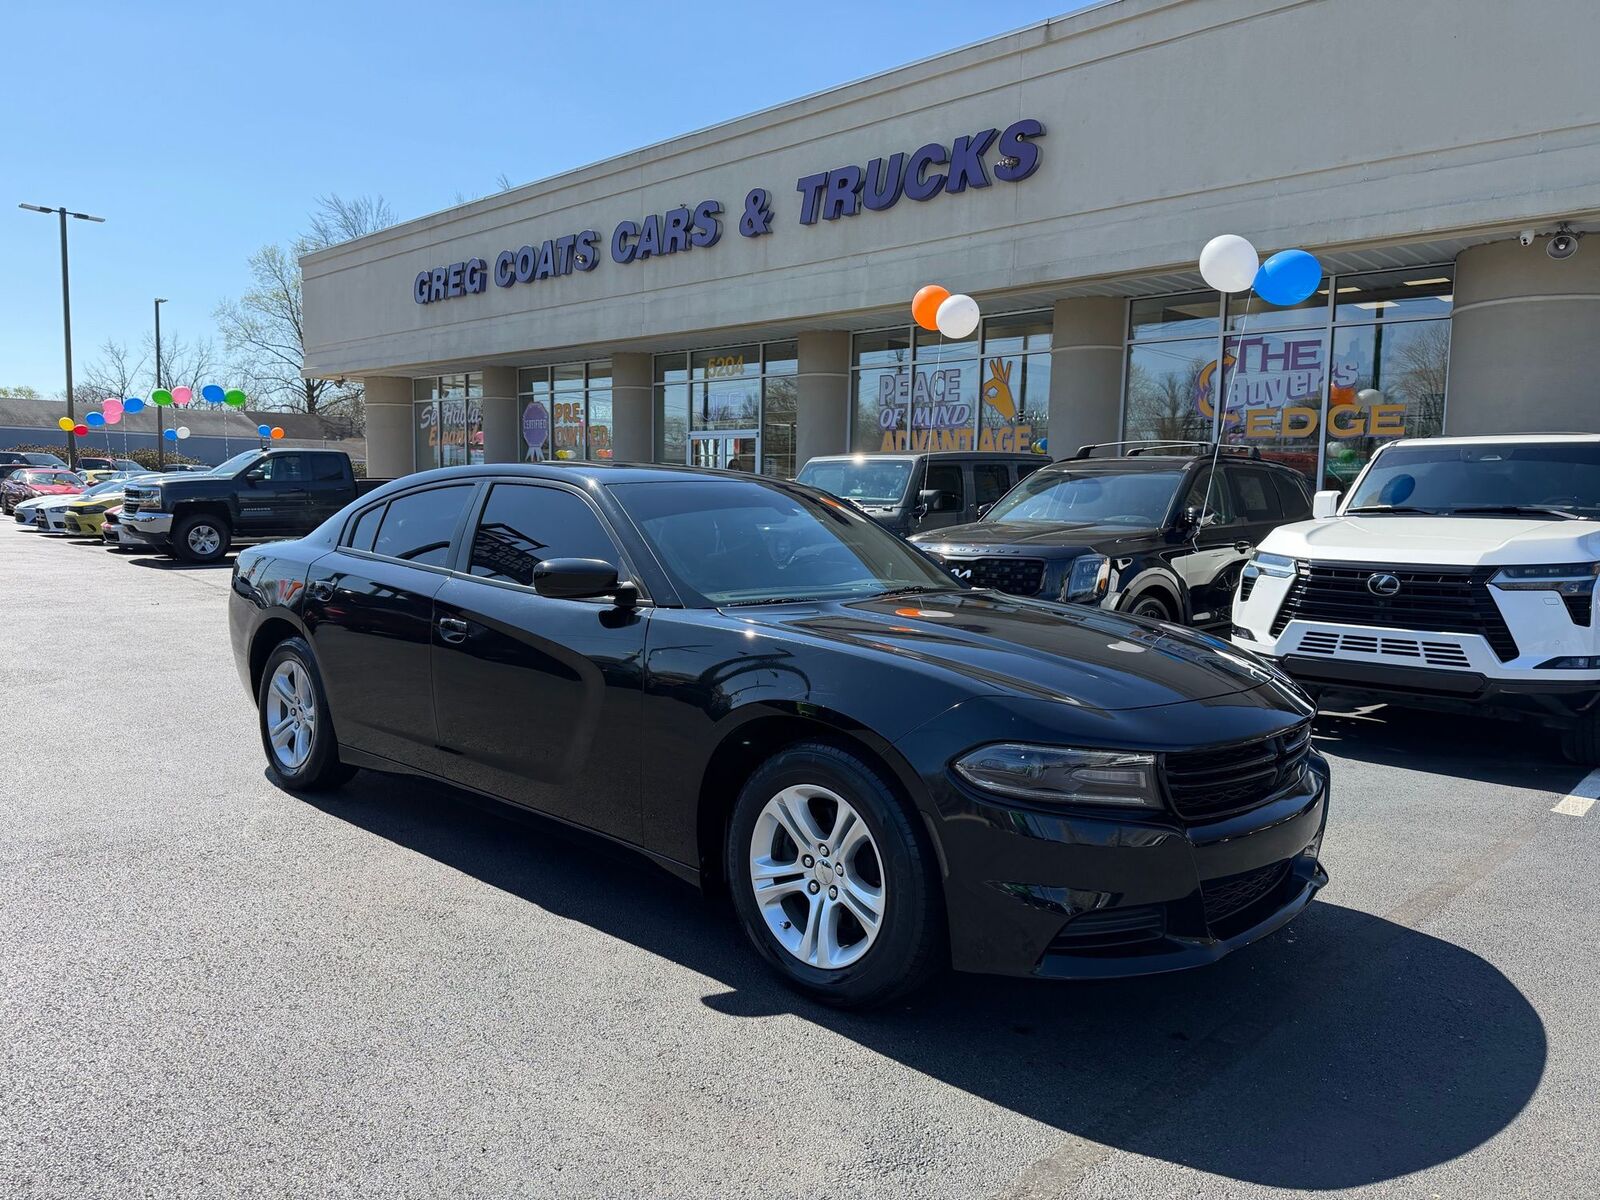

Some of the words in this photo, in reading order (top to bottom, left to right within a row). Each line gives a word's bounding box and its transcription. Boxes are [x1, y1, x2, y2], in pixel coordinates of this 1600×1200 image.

[414, 257, 487, 305] GREG
[494, 229, 600, 288] COATS
[611, 200, 725, 264] CARS
[739, 187, 774, 238] &
[796, 118, 1046, 226] TRUCKS
[708, 355, 744, 378] 5204
[1225, 336, 1322, 374] THE
[879, 368, 961, 407] PEACE
[420, 405, 438, 429] Se
[442, 401, 481, 425] Habla
[523, 418, 547, 430] CERTIFIED
[880, 407, 905, 430] OF
[912, 403, 971, 430] MIND
[1246, 404, 1407, 439] EDGE
[881, 424, 1032, 454] ADVANTAGE
